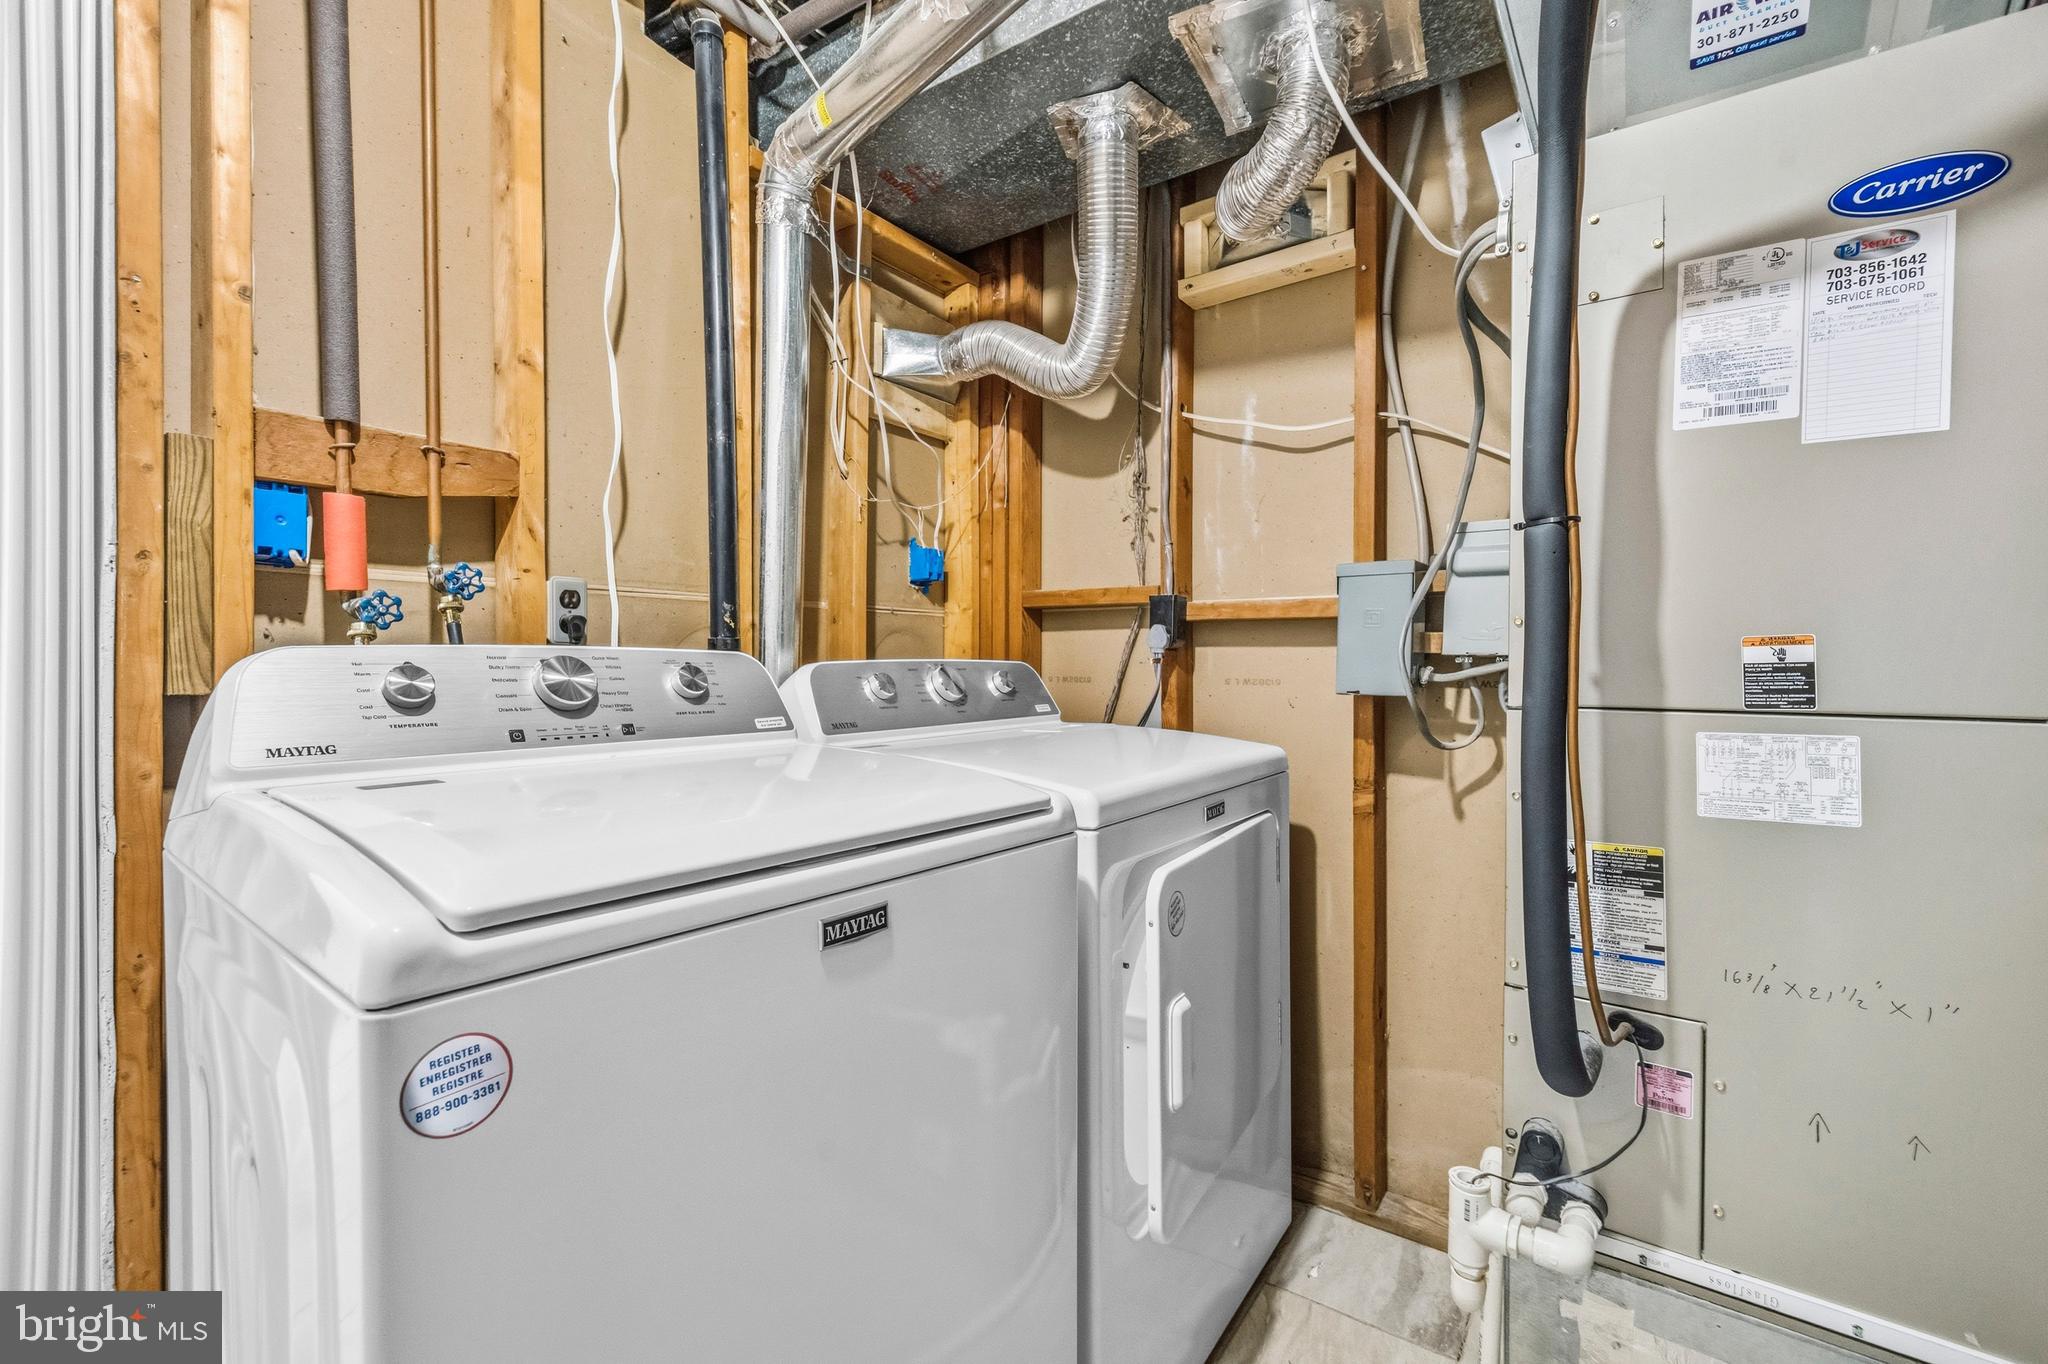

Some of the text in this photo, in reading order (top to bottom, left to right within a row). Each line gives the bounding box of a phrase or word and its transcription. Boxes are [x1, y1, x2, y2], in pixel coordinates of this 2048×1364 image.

[1696, 2, 1734, 25] AIR
[1697, 8, 1799, 49] 301-871-2250
[1852, 162, 1985, 205] Carrier
[1861, 234, 1907, 251] Service
[1826, 252, 1928, 281] 703-856-1642
[1826, 265, 1926, 293] 703-675-1061
[1826, 280, 1926, 306] SERVICE RECORD
[265, 744, 337, 759] MAYTAG
[825, 910, 886, 943] MAYTAG
[420, 1053, 493, 1088] ENREGISTRER
[429, 1044, 481, 1070] REGISTER
[432, 1069, 485, 1096] REGISTRE
[415, 1081, 501, 1123] 888-900-3381
[1708, 1275, 1780, 1309] Glasfloss
